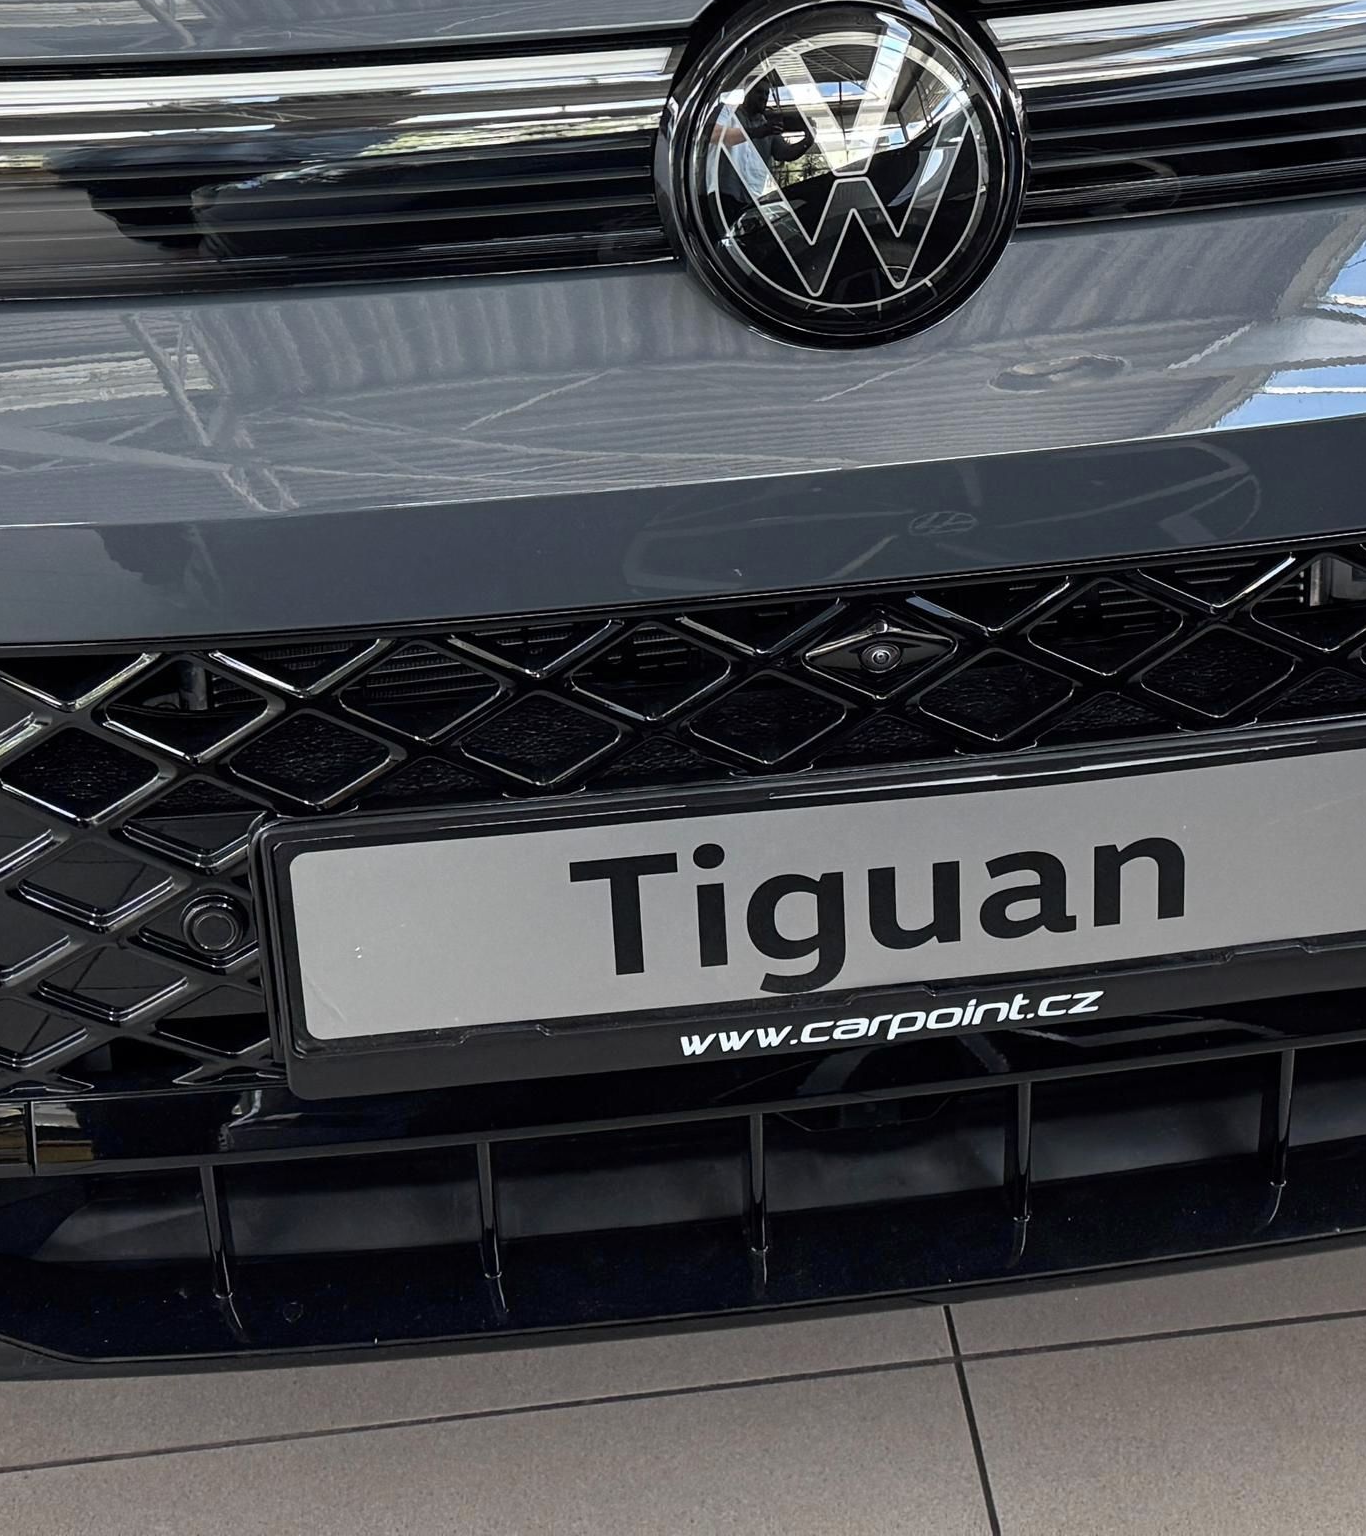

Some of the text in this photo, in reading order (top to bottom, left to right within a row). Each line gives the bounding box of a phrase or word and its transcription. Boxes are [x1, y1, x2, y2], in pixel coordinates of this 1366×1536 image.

[715, 32, 981, 307] VW
[568, 837, 1187, 994] Tiguan
[679, 990, 1104, 1056] www.carpoint.cz
